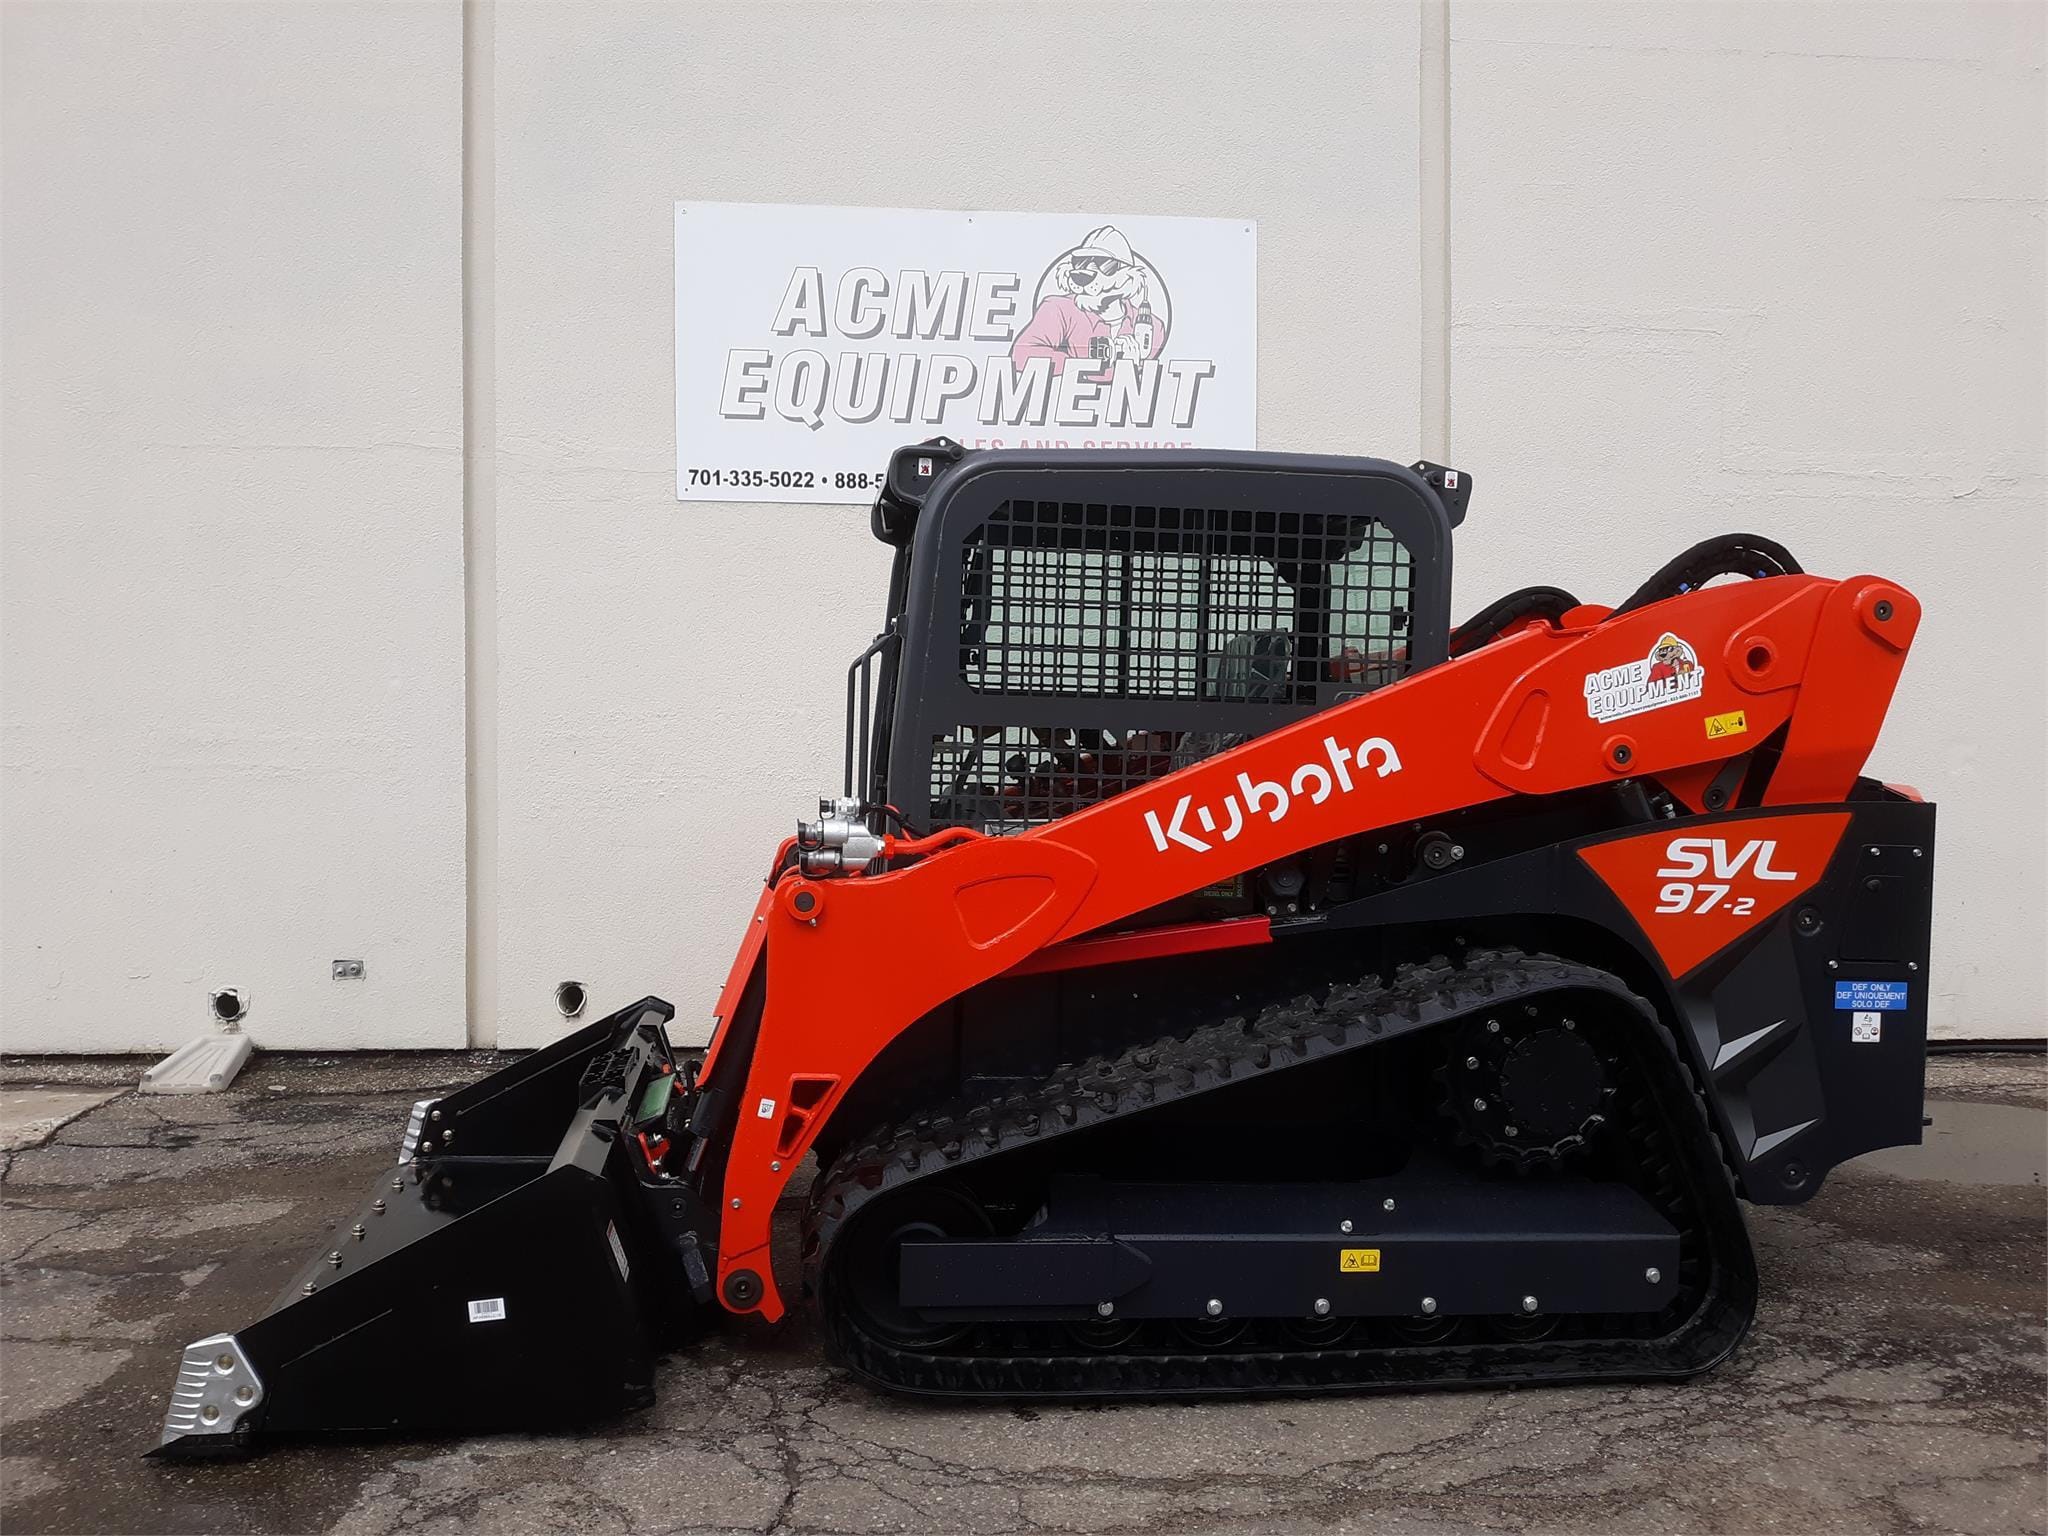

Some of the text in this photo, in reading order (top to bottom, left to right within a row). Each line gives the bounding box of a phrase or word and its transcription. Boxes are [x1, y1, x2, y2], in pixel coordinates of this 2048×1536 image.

[770, 266, 1019, 340] ACME
[718, 348, 1217, 432] EQUIPMENT
[688, 469, 815, 488] 701-335-5022
[1587, 664, 1642, 694] ACME
[1590, 669, 1702, 714] EQUIPMENT
[1143, 736, 1402, 853] Kubota
[1656, 838, 1797, 881] SVL
[1654, 883, 1756, 915] 97-2
[1836, 991, 1906, 1000] DEF UNIQUEMENT
[1852, 983, 1892, 992] DEF ONLY
[1851, 1000, 1891, 1008] SOLO DEF
